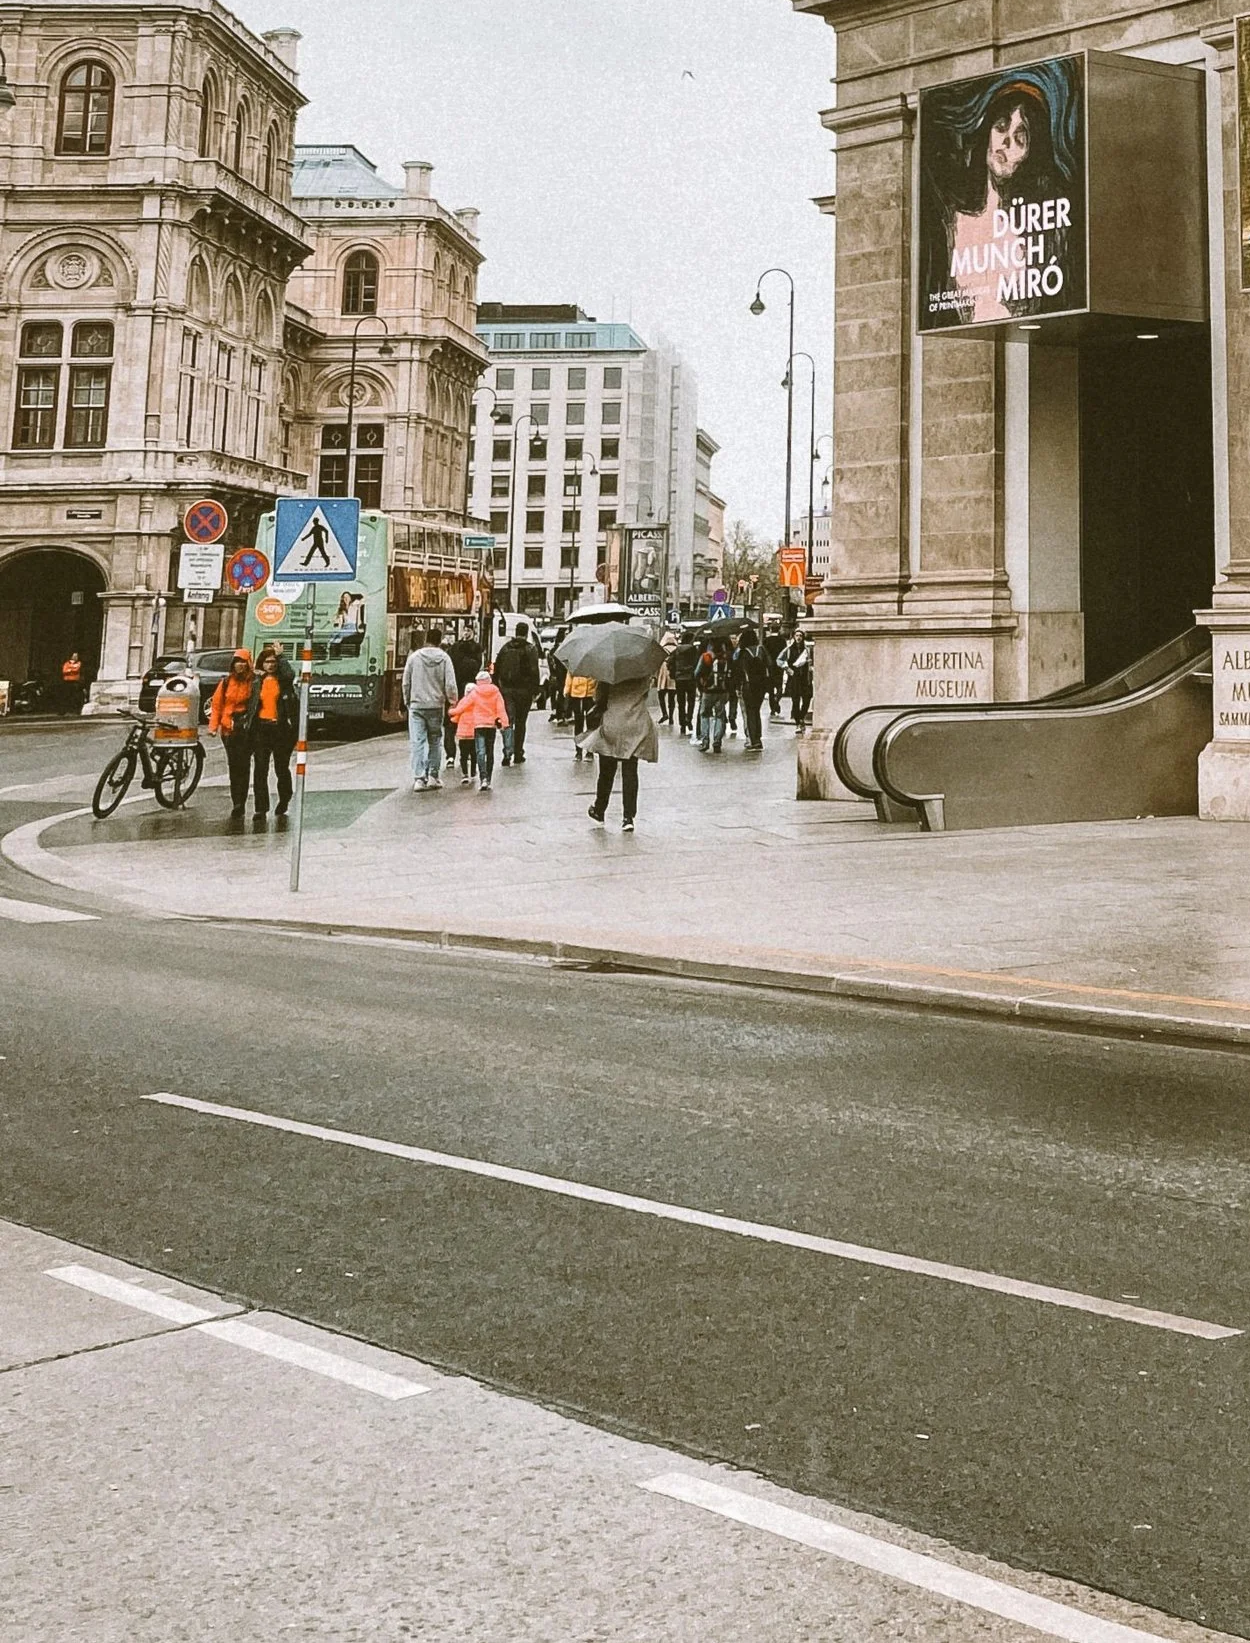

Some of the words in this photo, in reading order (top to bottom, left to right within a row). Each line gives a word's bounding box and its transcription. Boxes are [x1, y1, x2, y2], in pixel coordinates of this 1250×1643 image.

[993, 197, 1071, 239] DÜRER
[950, 234, 1044, 277] MUNCH
[996, 255, 1063, 302] MIRÓ
[929, 292, 940, 302] THE
[929, 303, 938, 313] OF
[909, 651, 985, 670] ALBERTINA
[915, 680, 978, 698] MUSEUM
